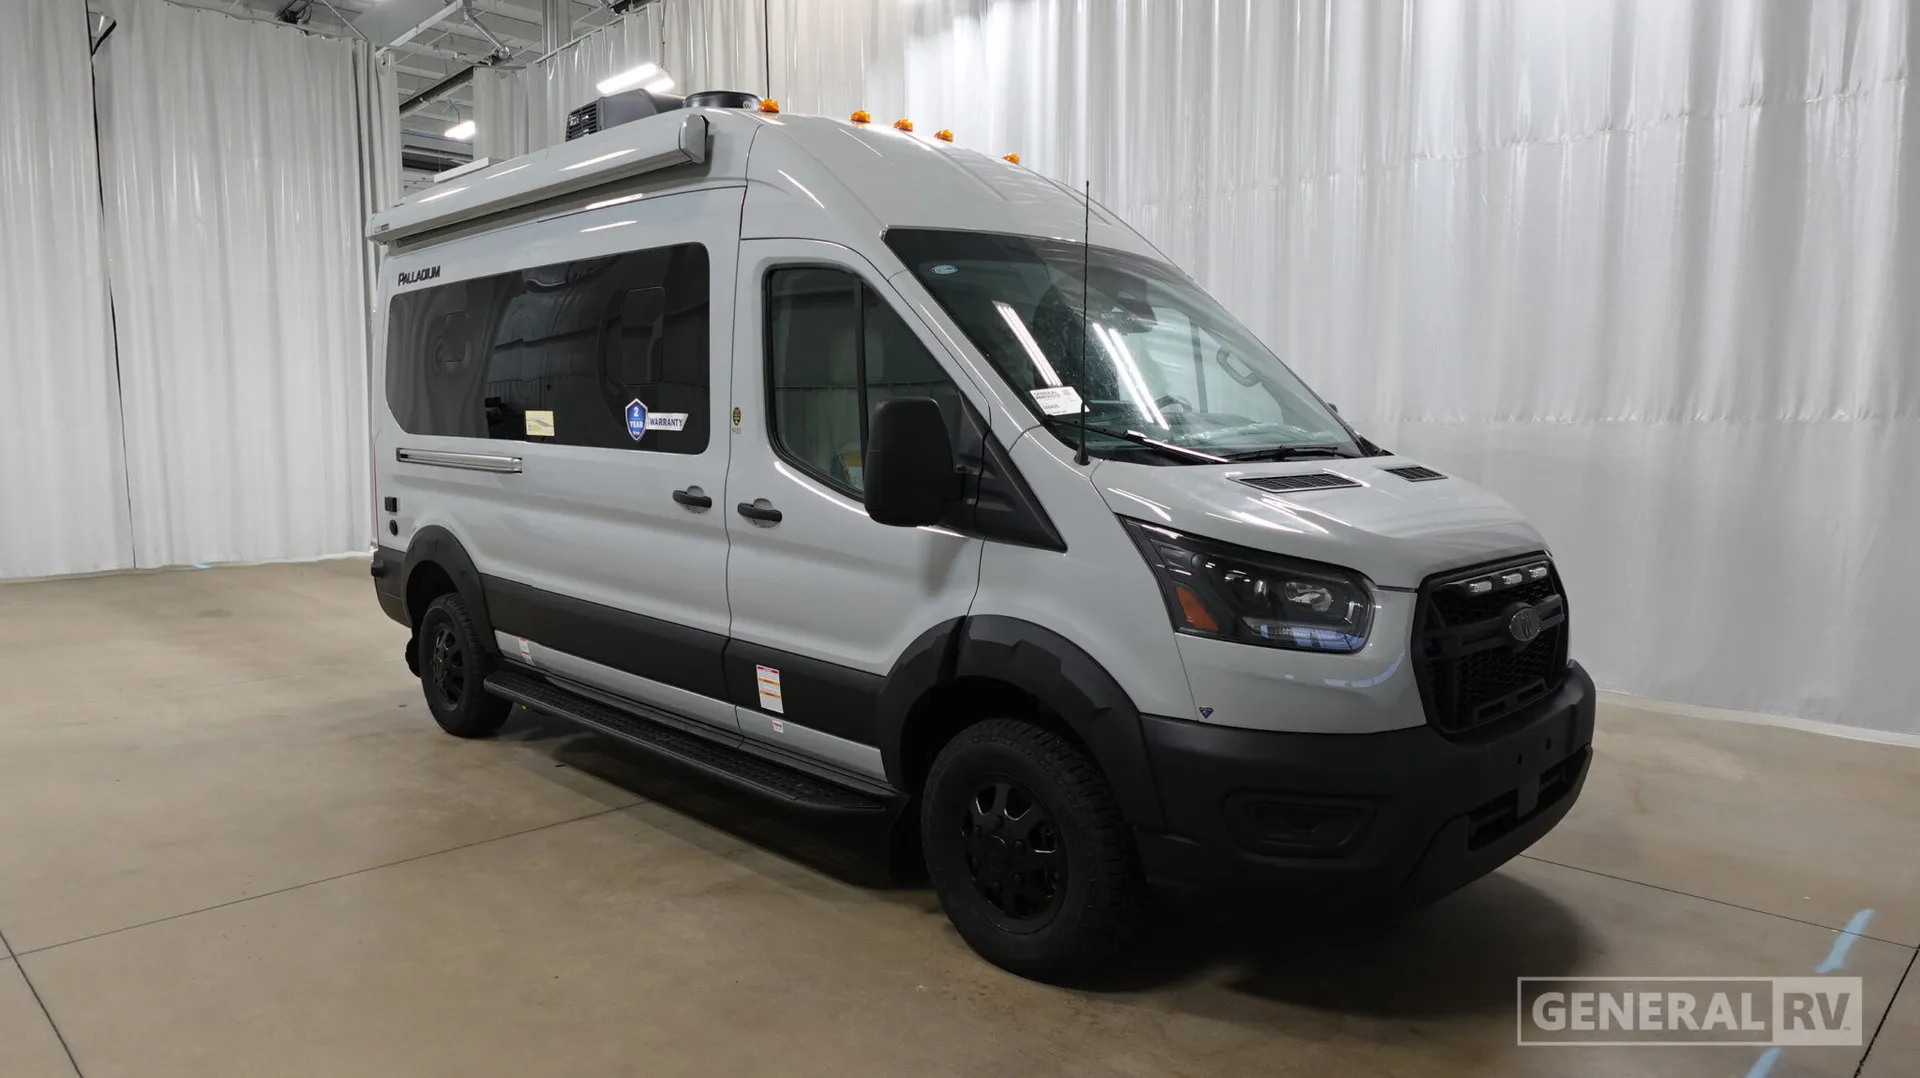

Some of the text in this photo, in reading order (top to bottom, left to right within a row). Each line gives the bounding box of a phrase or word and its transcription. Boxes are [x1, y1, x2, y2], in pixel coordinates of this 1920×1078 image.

[397, 265, 441, 286] PALLADIUM
[633, 407, 640, 418] 2
[629, 420, 644, 429] YEAR
[650, 418, 684, 428] WARRANTY
